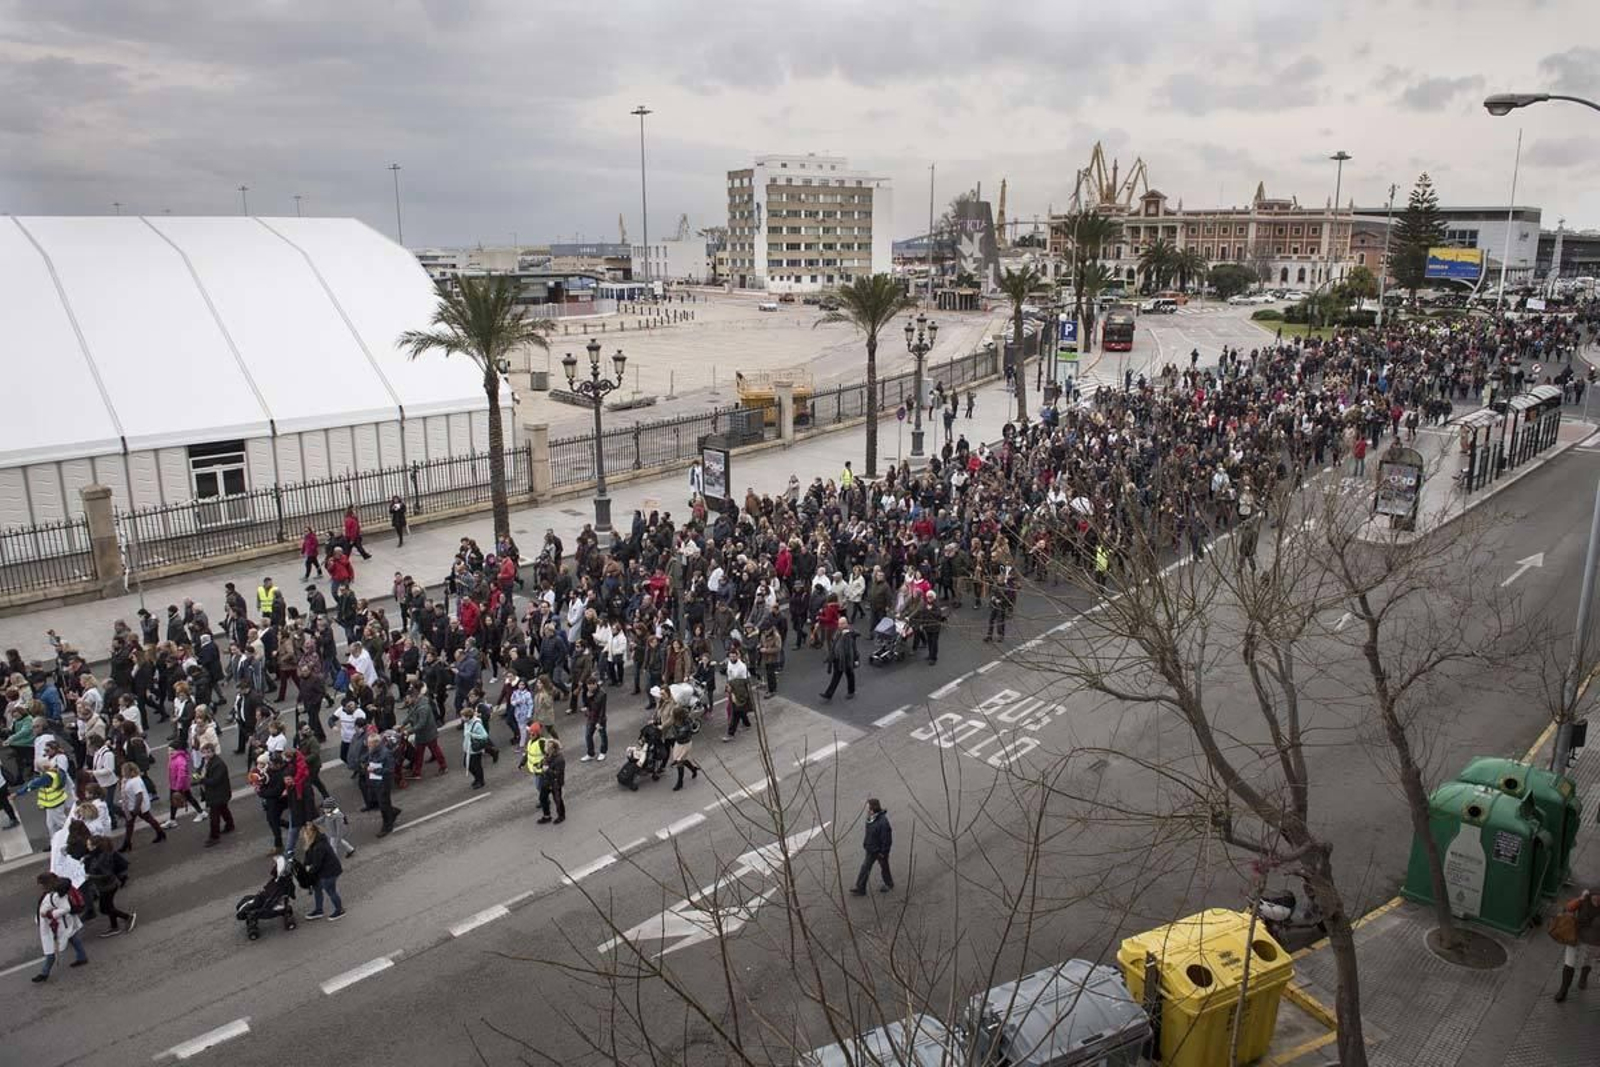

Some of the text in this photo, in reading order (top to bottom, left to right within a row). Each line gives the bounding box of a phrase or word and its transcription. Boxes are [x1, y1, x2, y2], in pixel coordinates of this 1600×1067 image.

[1065, 324, 1073, 335] P
[972, 689, 1066, 730] BUS
[910, 713, 1040, 766] SOLO
